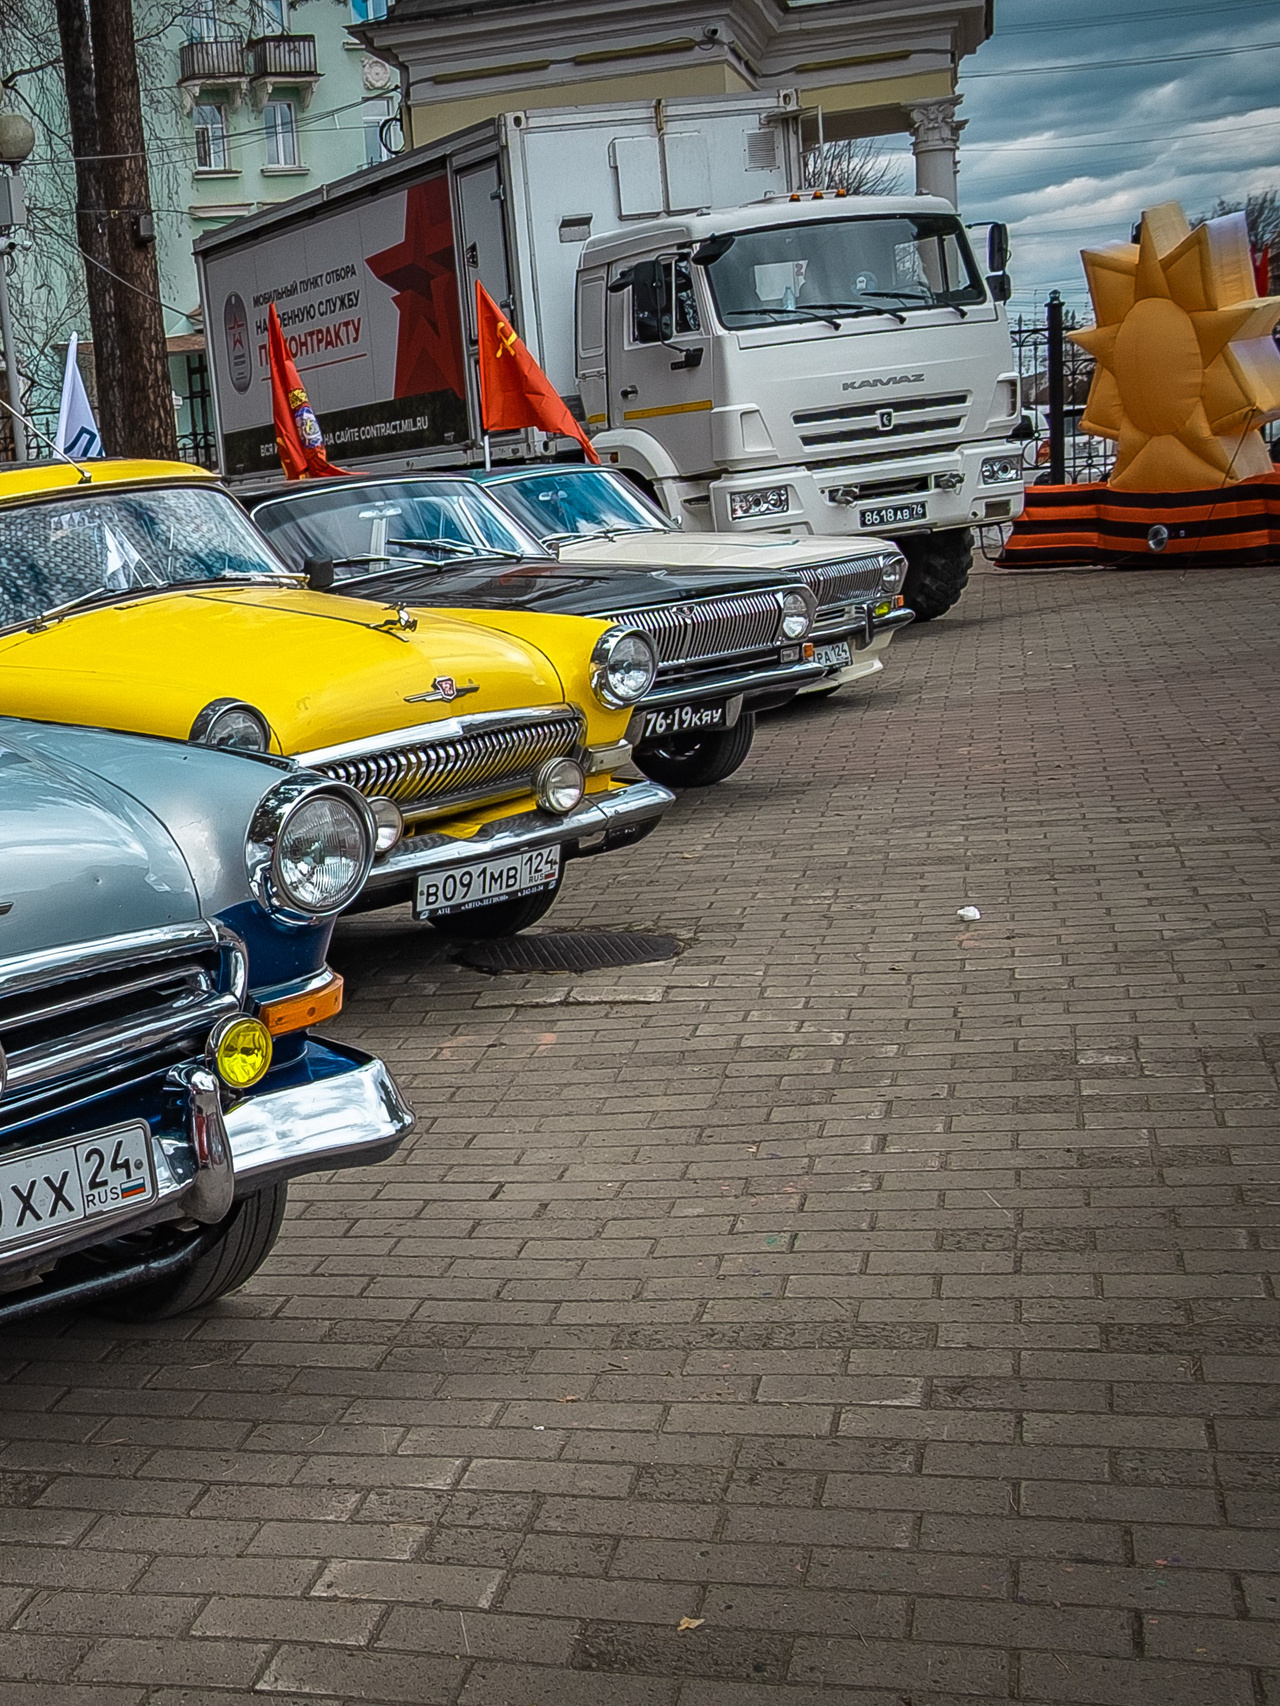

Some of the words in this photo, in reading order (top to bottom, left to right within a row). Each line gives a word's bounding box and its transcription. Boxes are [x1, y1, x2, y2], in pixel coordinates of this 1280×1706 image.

[253, 281, 299, 308] МОБИЛЬНЫЙ
[299, 274, 324, 293] ПУНКТ
[325, 264, 357, 285] ОТБОРА
[255, 318, 269, 335] НА
[276, 303, 316, 328] ОЕННУЮ
[317, 289, 360, 316] СЛУЖБУ
[842, 373, 925, 391] KAMAZ
[323, 433, 335, 446] НА
[335, 427, 360, 443] САЙТЕ
[360, 416, 429, 439] CONTRACT.MIL.RU
[524, 848, 554, 876] 124
[528, 874, 544, 884] RUS
[83, 1139, 132, 1191] 24
[85, 1186, 120, 1209] RUS
